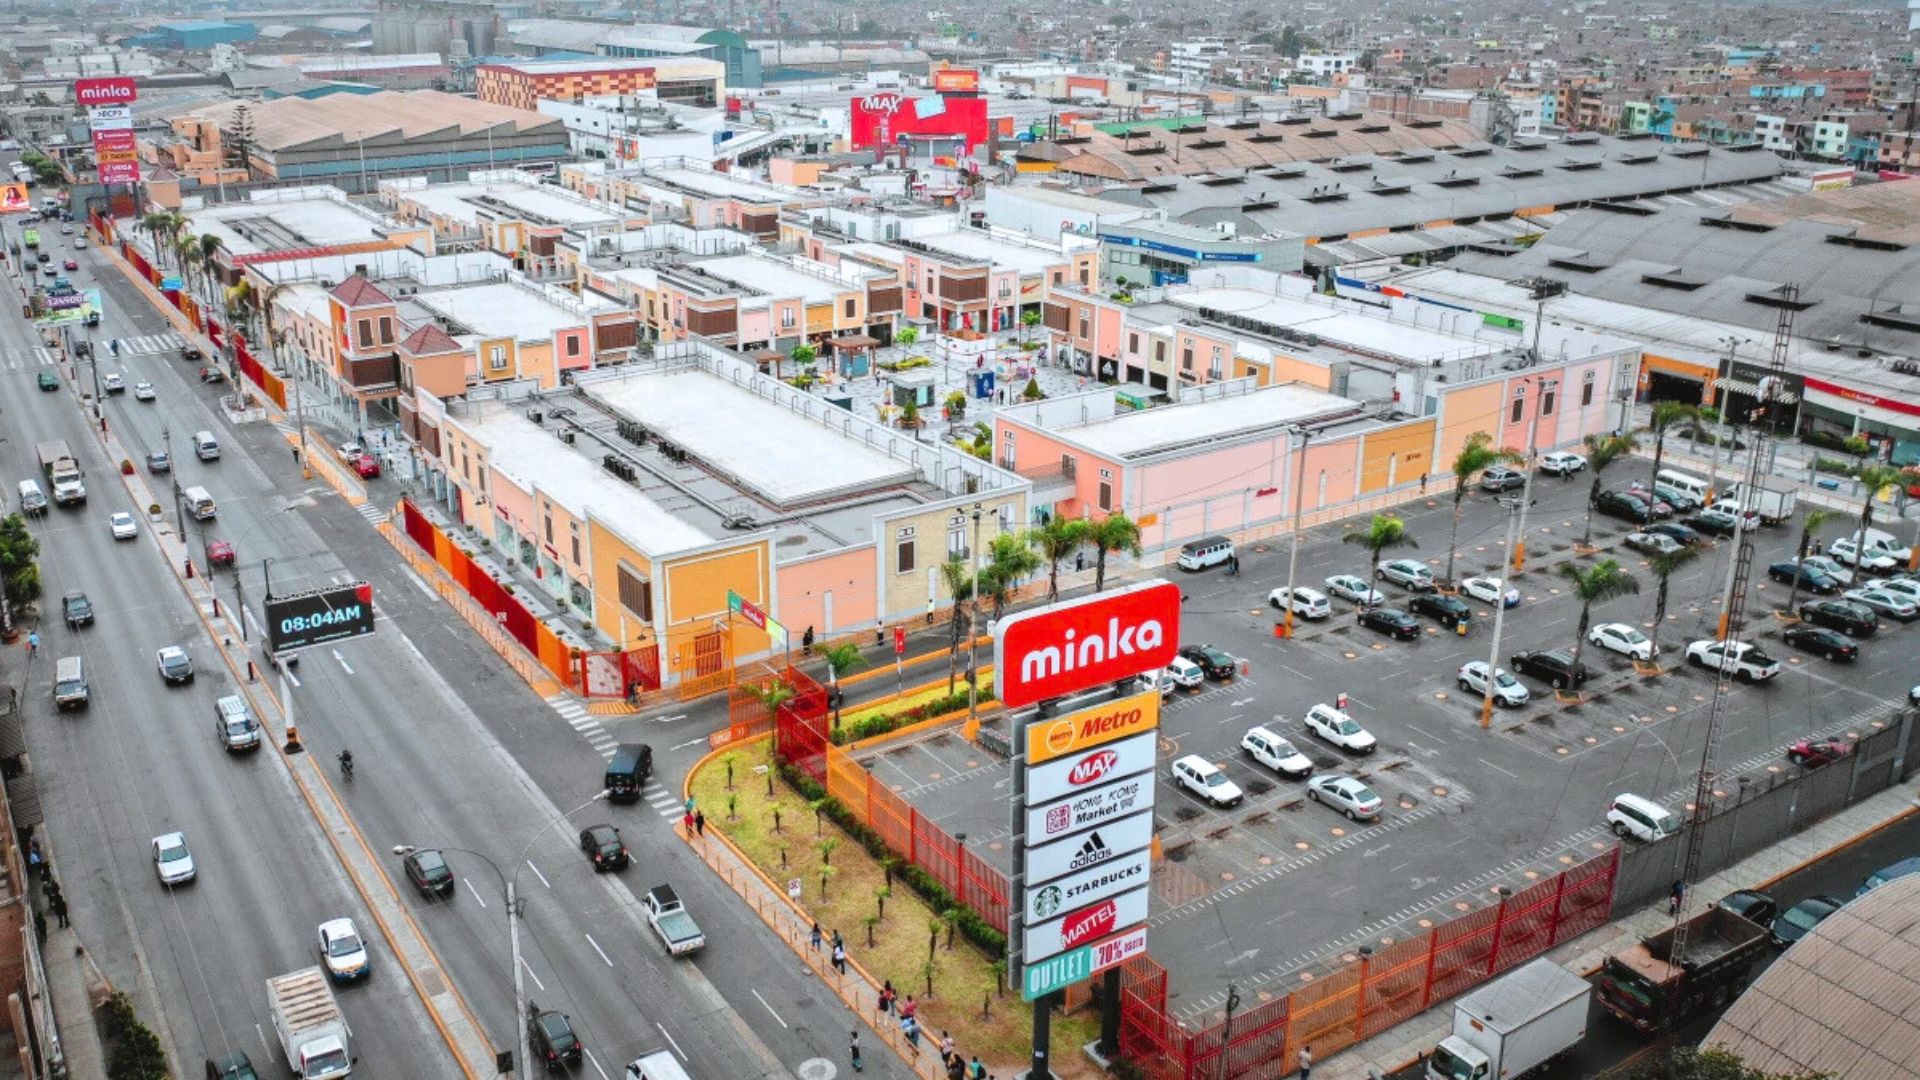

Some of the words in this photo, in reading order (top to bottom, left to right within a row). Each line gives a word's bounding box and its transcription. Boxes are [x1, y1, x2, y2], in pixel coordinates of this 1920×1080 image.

[81, 84, 131, 98] minka
[863, 94, 902, 117] MAX
[281, 605, 361, 634] 08:04AM
[1021, 617, 1163, 684] minka
[1079, 708, 1142, 739] Metro
[1073, 750, 1117, 780] MAX
[1075, 803, 1118, 824] Market
[1070, 848, 1112, 869] adidas
[1066, 863, 1142, 898] STARBUCKS
[1062, 904, 1116, 947] MATTEL
[1030, 951, 1085, 993] OUTLET
[1099, 941, 1122, 965] 70%
